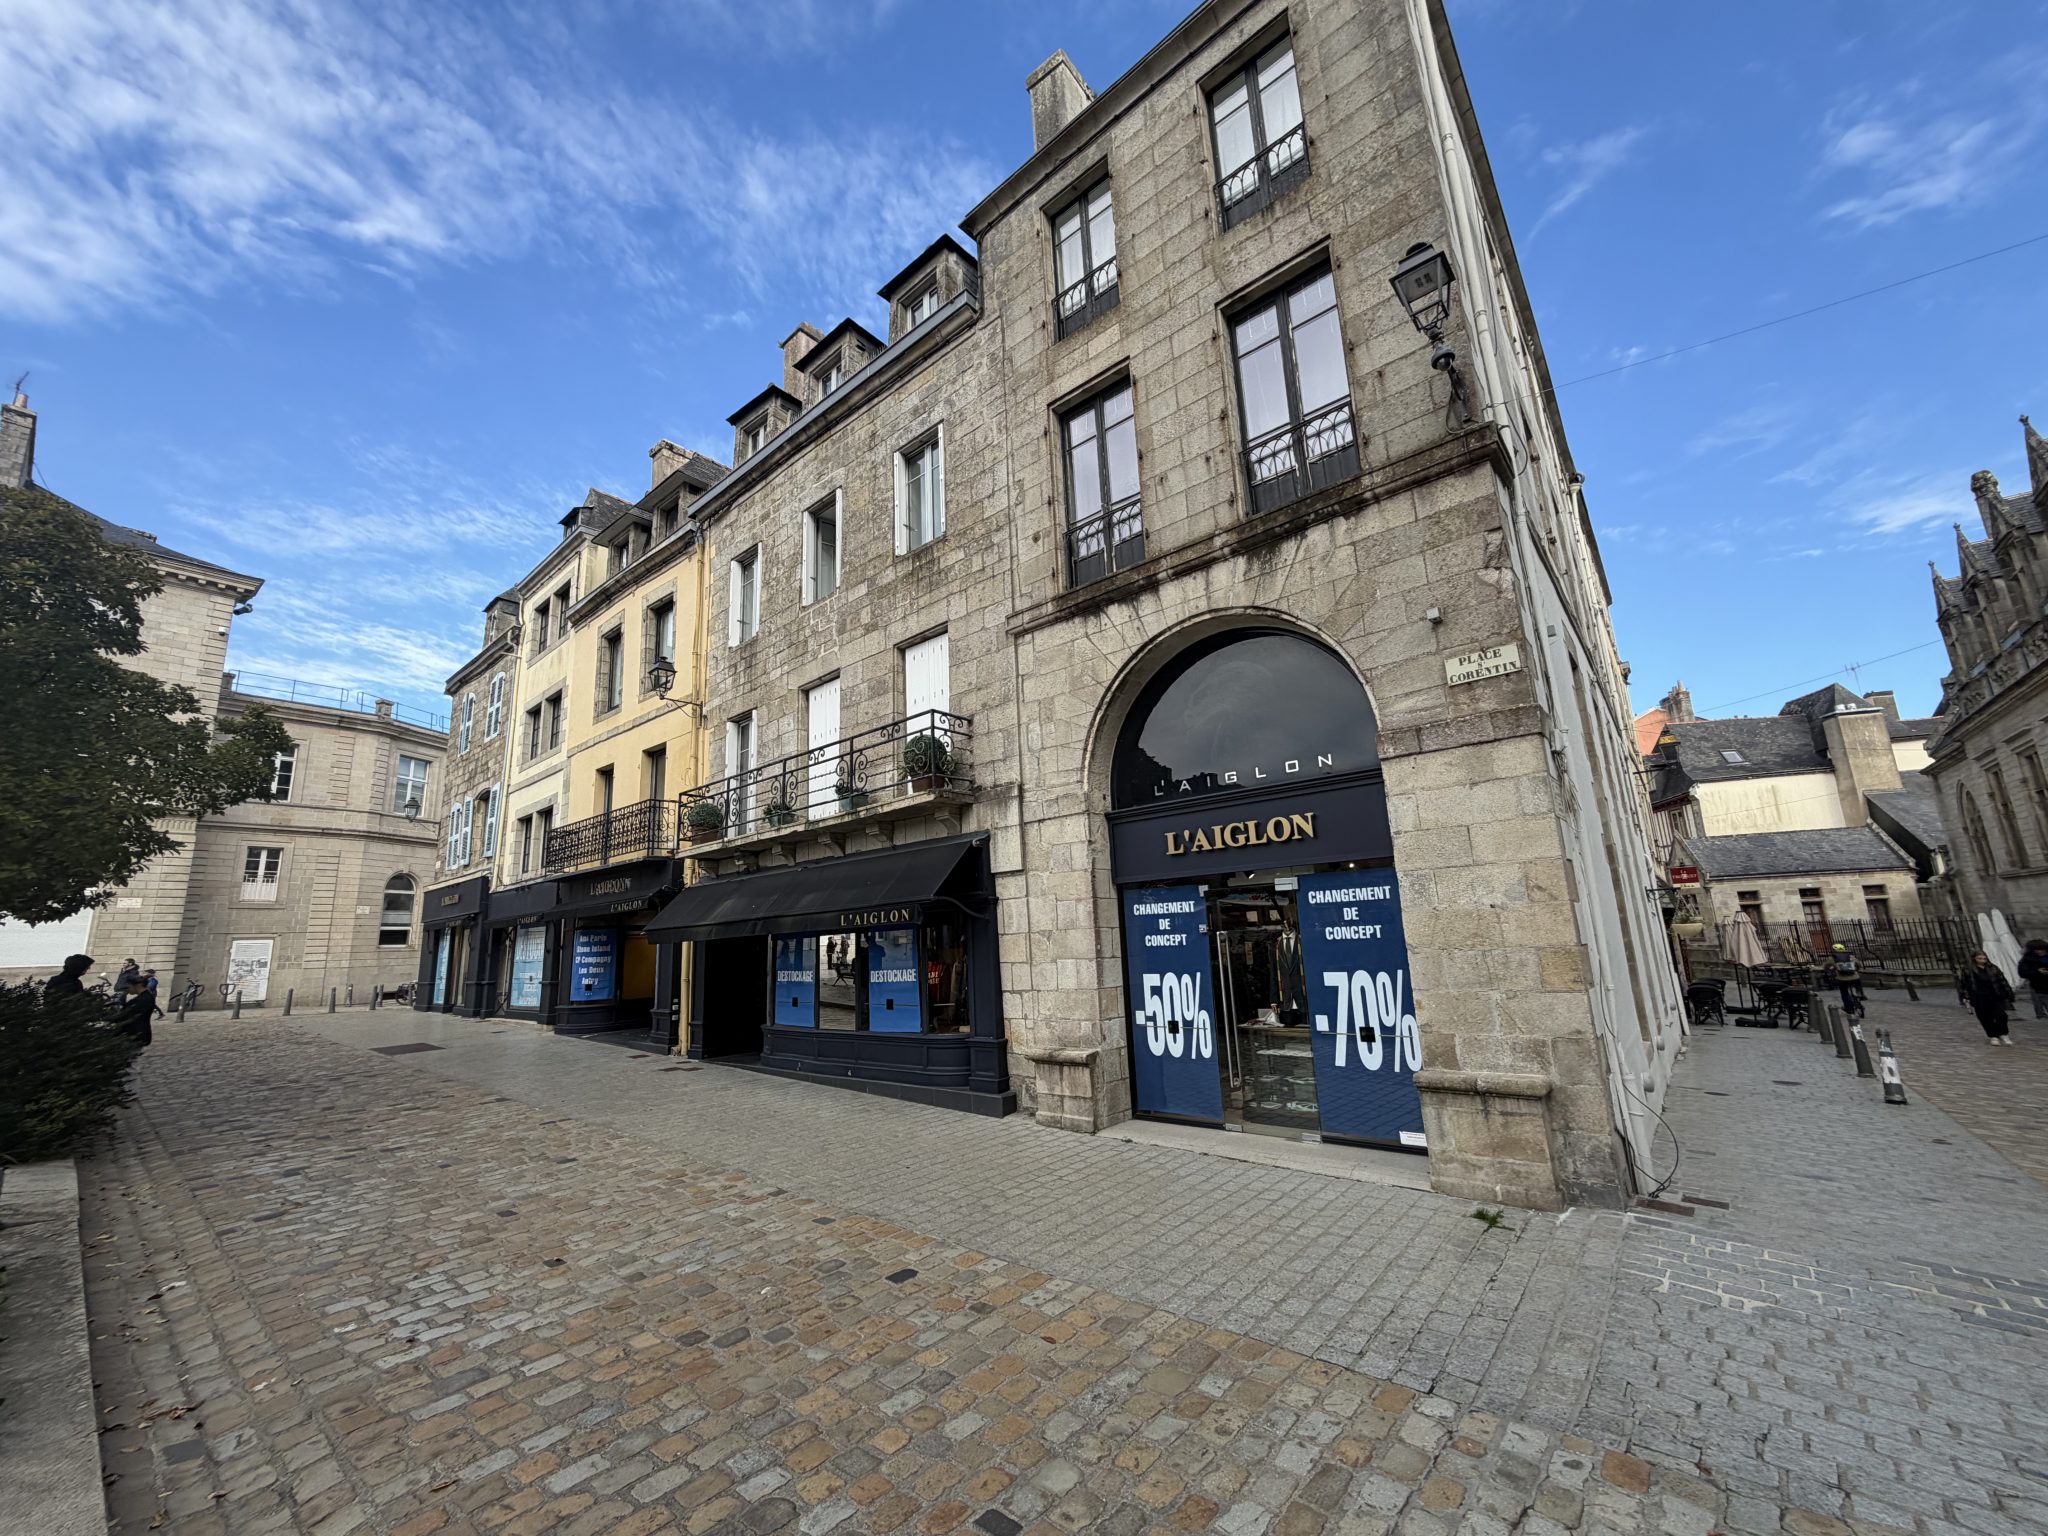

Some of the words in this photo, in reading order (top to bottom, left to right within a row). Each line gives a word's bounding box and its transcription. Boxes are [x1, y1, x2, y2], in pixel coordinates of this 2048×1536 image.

[1458, 648, 1502, 667] PLACE
[1449, 660, 1518, 684] CORENTIN
[1154, 753, 1333, 796] L'AIGLON
[1164, 812, 1315, 855] L'AIGLON
[1307, 885, 1392, 904] CHANGEMENT
[840, 908, 911, 927] L'AIGLON
[1133, 901, 1195, 916] CHANGEMENT
[1343, 907, 1359, 921] DE
[1158, 918, 1171, 930] DE
[1325, 924, 1382, 940] CONCEPT
[1145, 934, 1188, 947] CONCEPT
[777, 970, 814, 982] DESTOCKAGE
[870, 968, 917, 983] DESTOCKAGE
[1135, 971, 1213, 1060] -50%
[1315, 969, 1423, 1073] -70%
